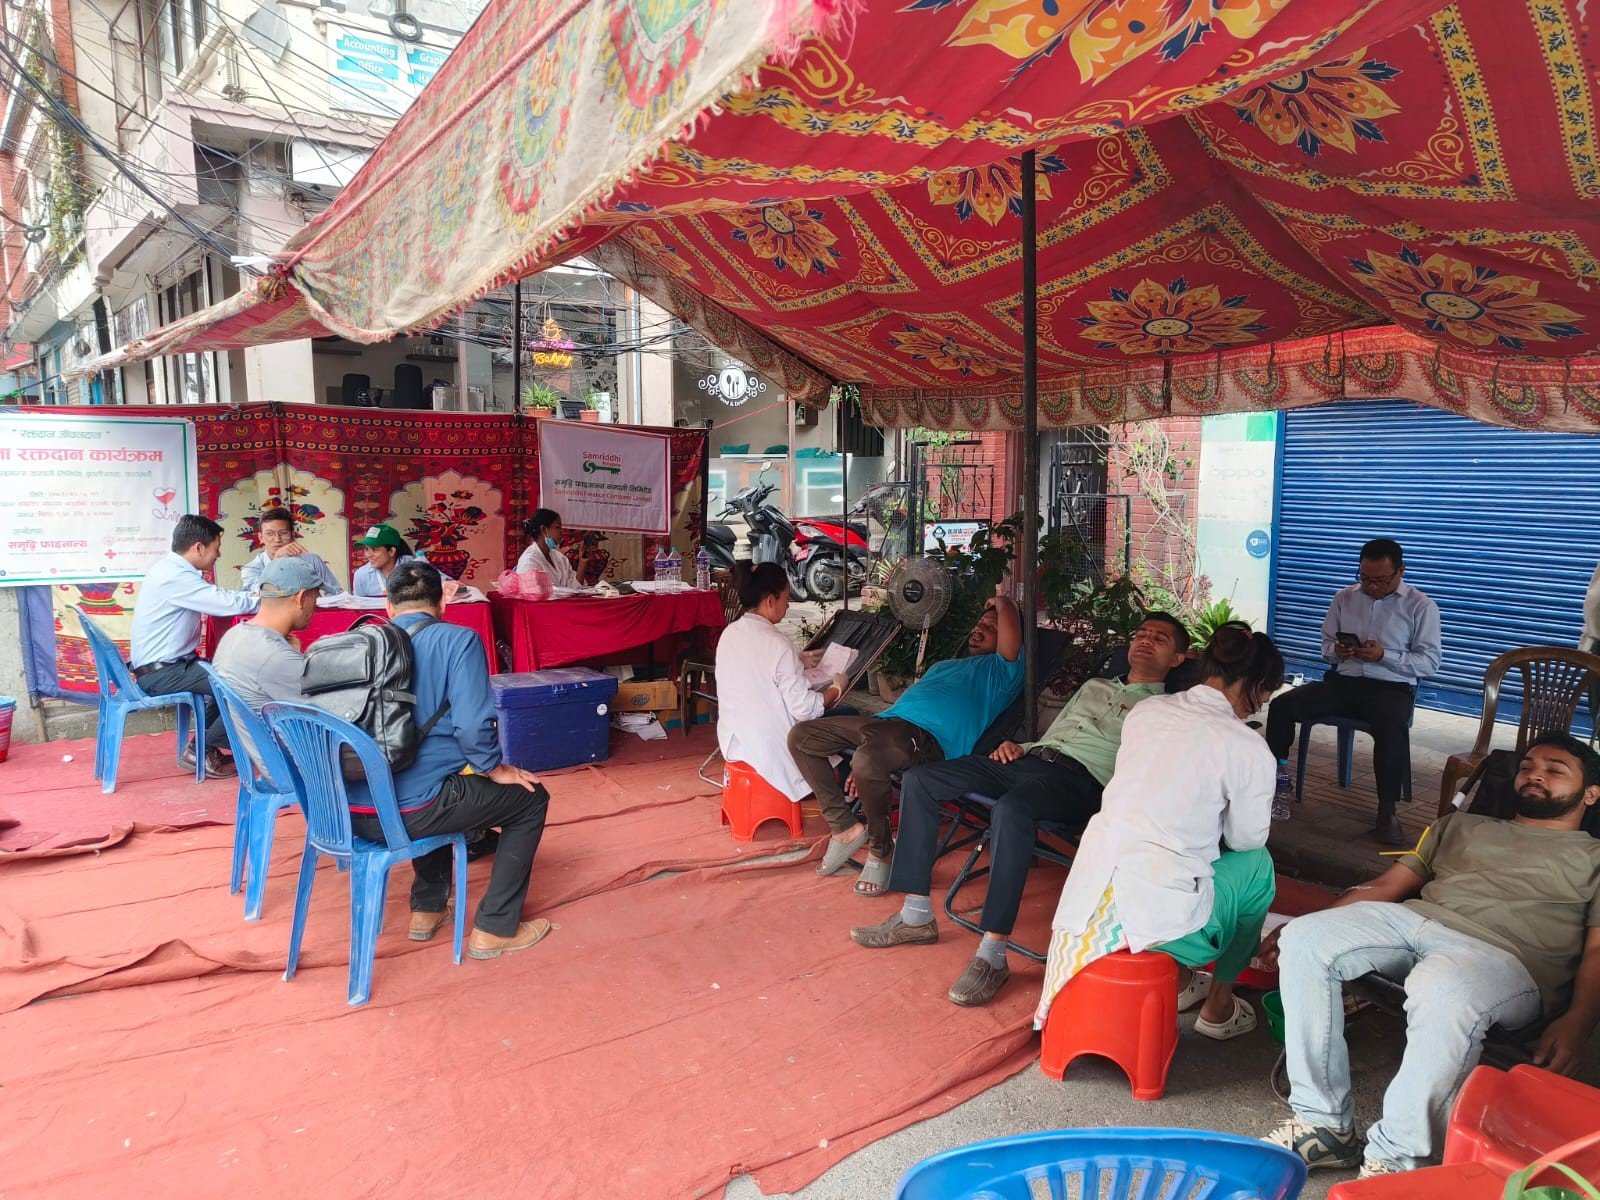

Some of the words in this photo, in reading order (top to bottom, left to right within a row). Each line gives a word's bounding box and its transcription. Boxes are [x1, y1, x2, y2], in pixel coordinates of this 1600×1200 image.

[343, 37, 396, 58] Accounting
[16, 448, 84, 461] रक्तदान
[88, 447, 163, 463] कार्यक्रम
[583, 451, 621, 462] Samriddhi
